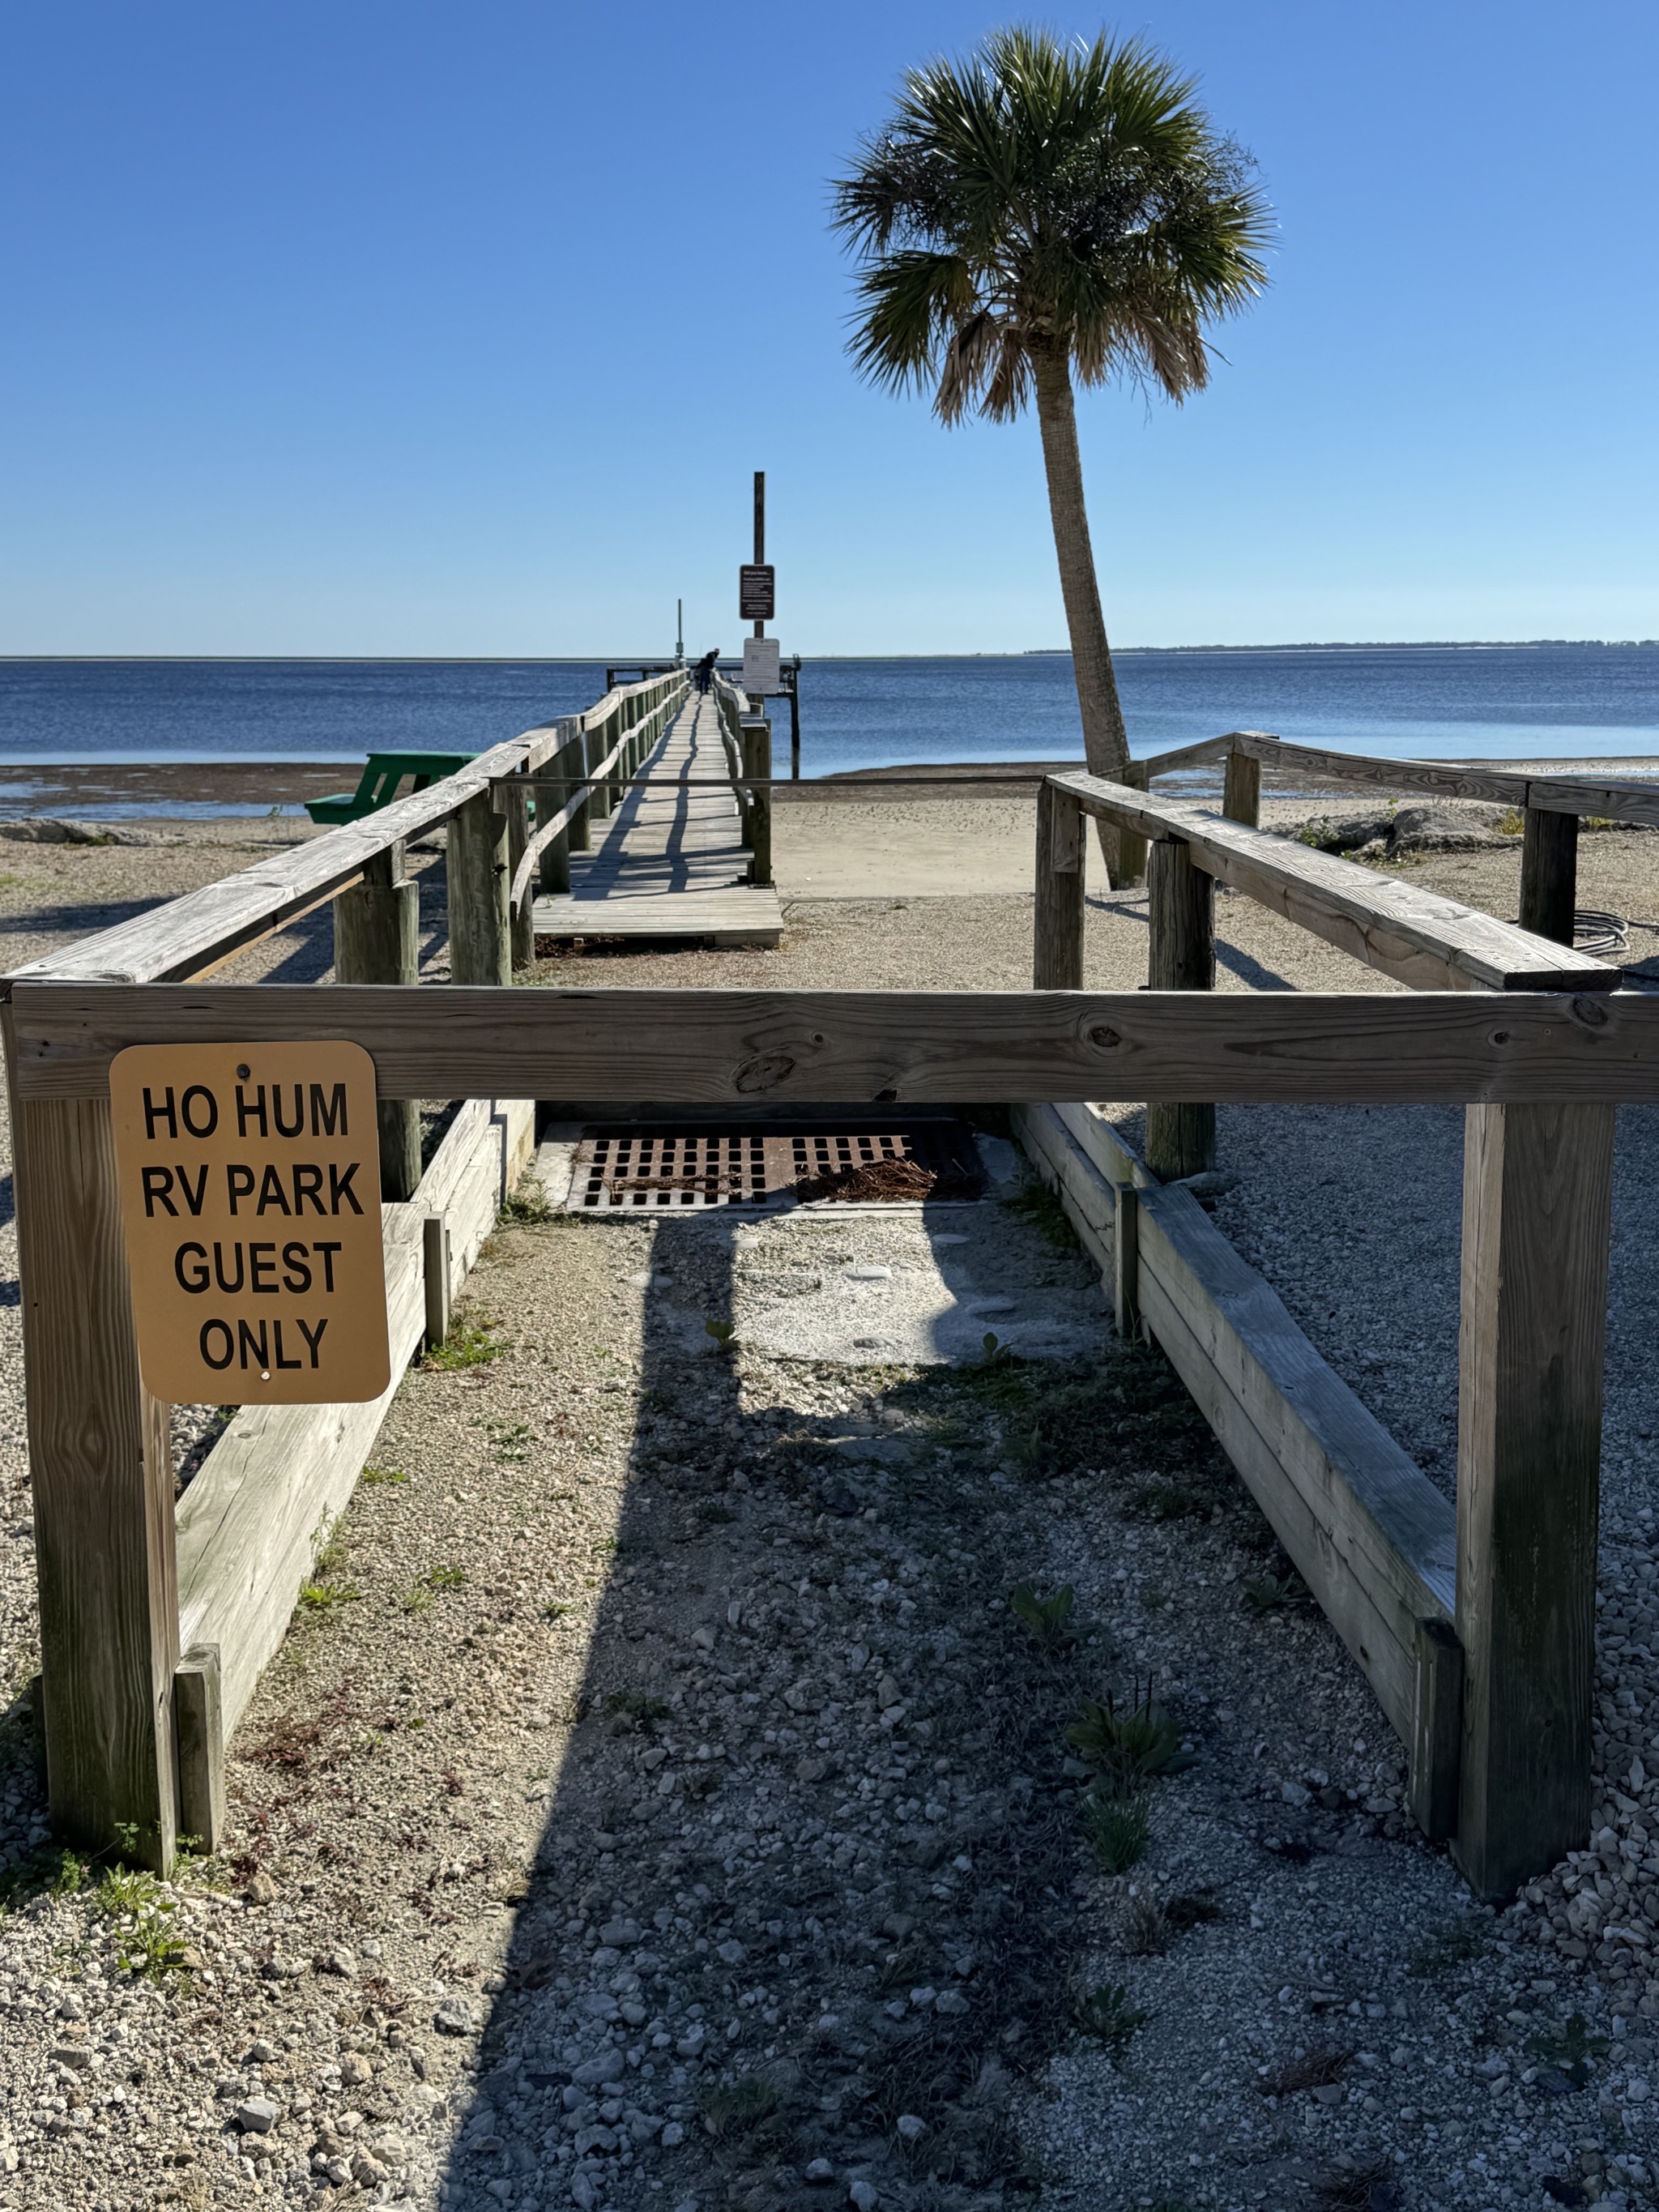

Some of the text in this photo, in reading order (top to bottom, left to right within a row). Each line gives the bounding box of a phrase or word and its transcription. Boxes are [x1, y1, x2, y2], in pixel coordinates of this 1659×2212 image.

[142, 1083, 348, 1140] HO HUM
[141, 1163, 365, 1218] RV PARK
[174, 1241, 342, 1294] GUEST
[199, 1318, 329, 1370] ONLY
